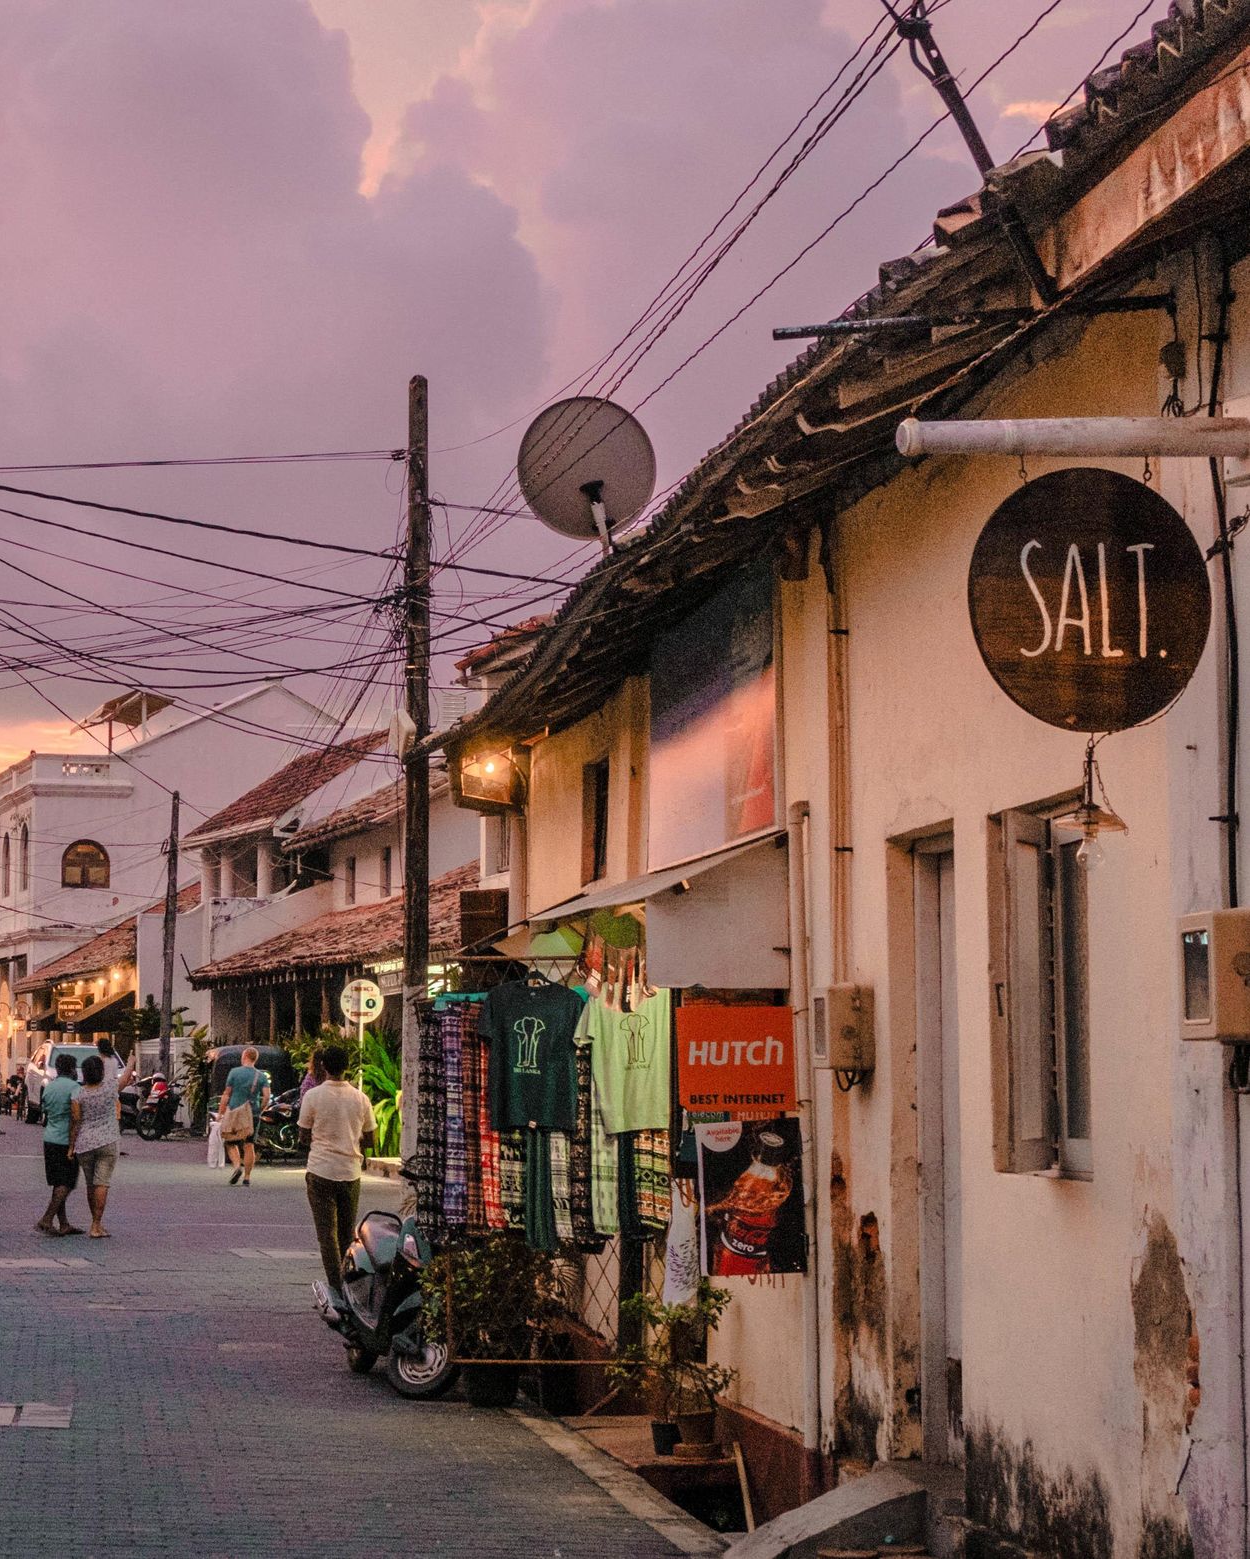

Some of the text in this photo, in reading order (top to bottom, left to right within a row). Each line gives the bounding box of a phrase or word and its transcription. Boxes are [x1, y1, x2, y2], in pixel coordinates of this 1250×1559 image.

[689, 1093, 786, 1105] BEST INTERNET
[706, 1127, 740, 1137] Available
[714, 1134, 732, 1142] here
[731, 1238, 755, 1252] zero
